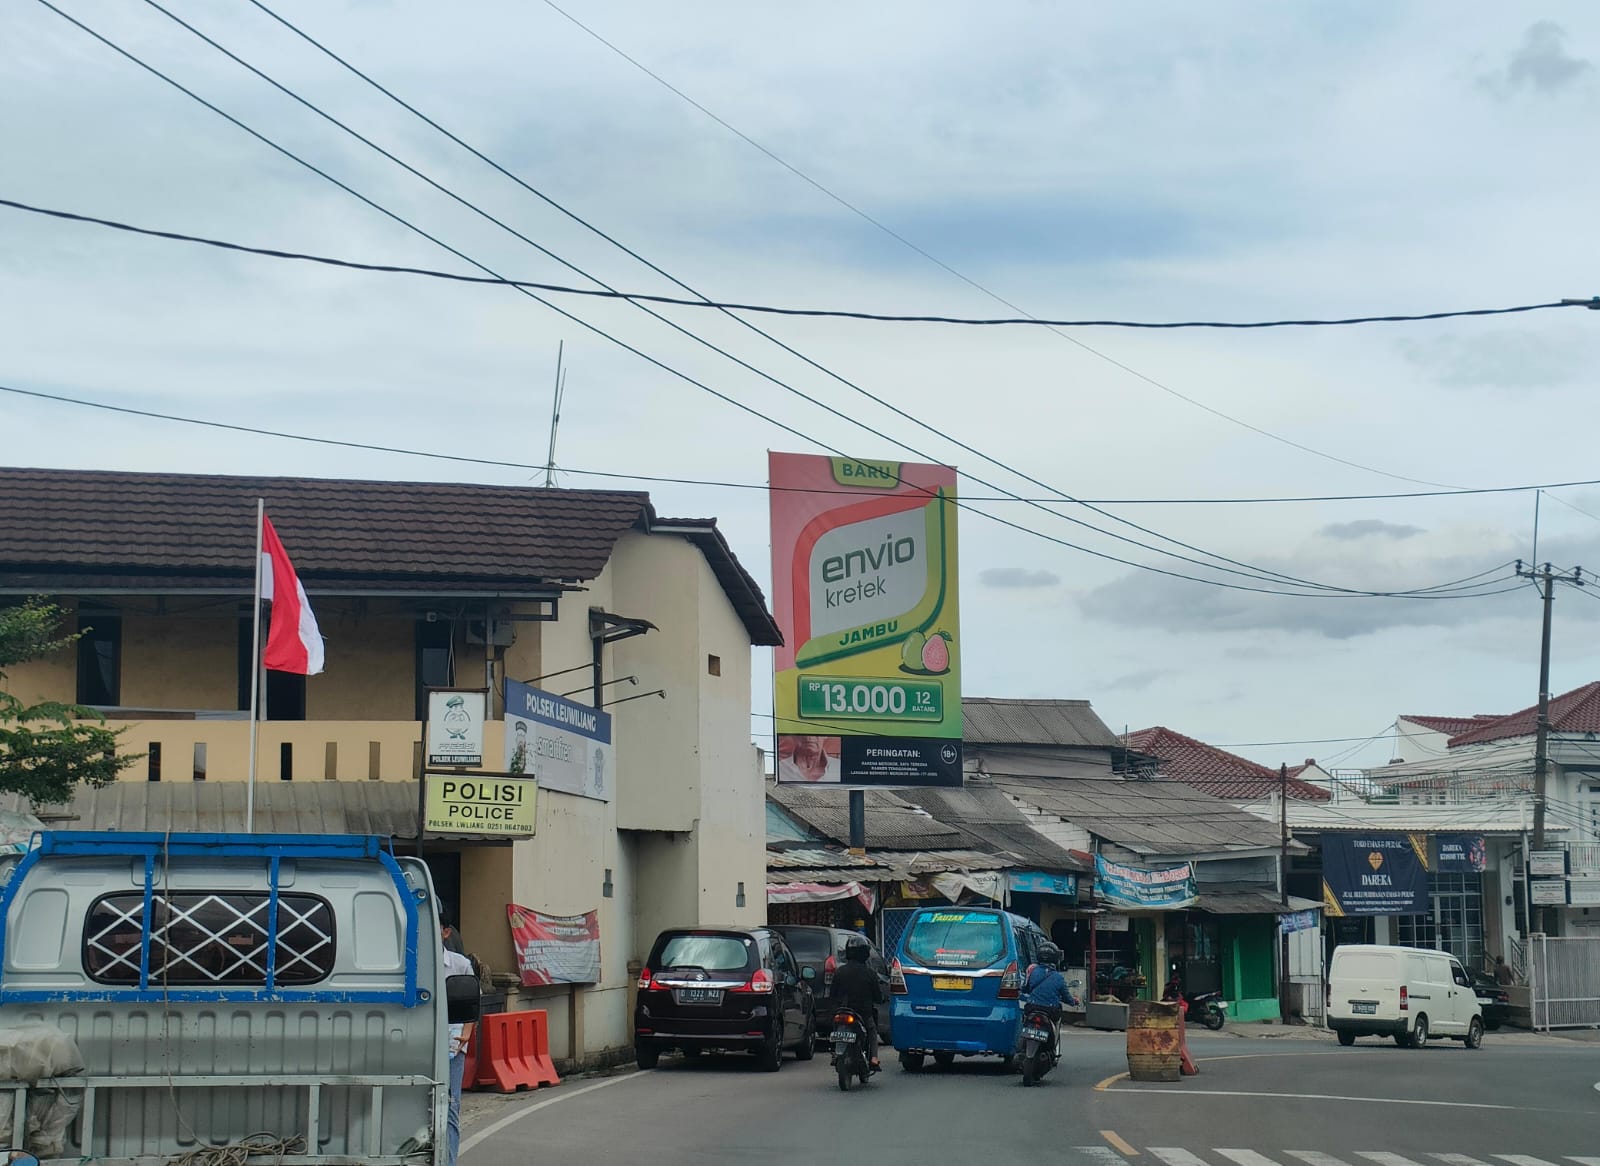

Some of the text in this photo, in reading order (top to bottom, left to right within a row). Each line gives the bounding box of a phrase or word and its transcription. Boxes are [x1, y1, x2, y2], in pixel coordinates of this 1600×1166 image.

[842, 463, 890, 479] BARU
[822, 533, 915, 583] envio
[826, 576, 886, 608] kretek
[839, 620, 899, 646] JAMBU
[526, 692, 555, 718] POLSEK
[822, 684, 906, 714] 13.000
[915, 692, 931, 704] 12
[912, 705, 936, 713] BATANG
[866, 749, 921, 758] PERINGATAN:
[943, 750, 955, 758] 18+
[443, 782, 522, 802] POLISI
[449, 805, 514, 820] POLICE
[428, 820, 453, 828] POLSEK
[1361, 874, 1392, 886] DAREKA
